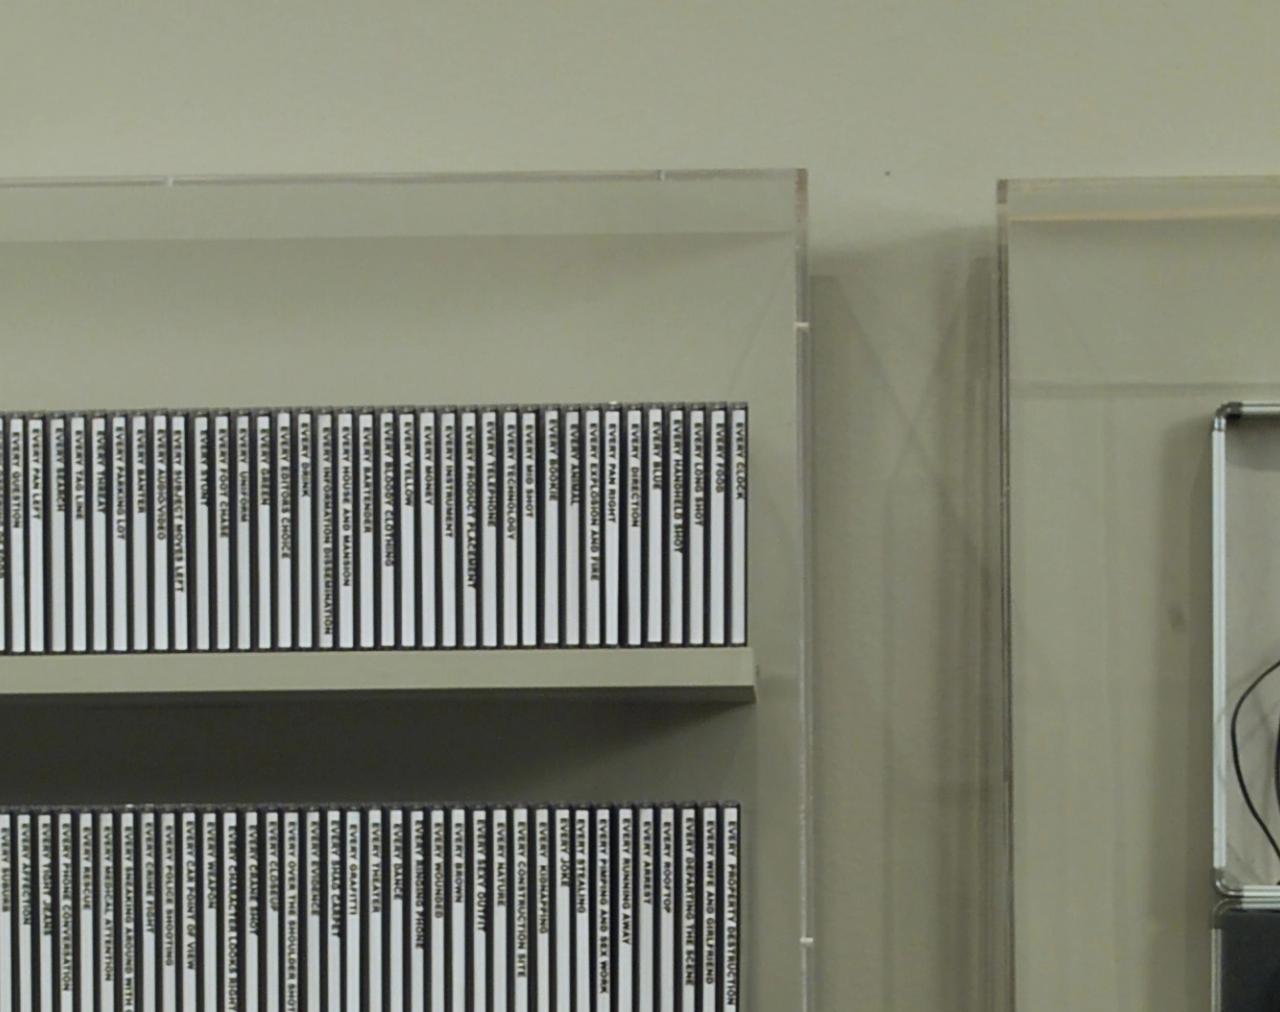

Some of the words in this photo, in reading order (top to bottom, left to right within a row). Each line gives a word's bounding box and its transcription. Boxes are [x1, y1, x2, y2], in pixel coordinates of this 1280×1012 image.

[11, 431, 22, 467] EVERY
[31, 428, 41, 463] EVERY
[239, 427, 248, 464] EVERY
[341, 425, 351, 462] EVERY
[362, 426, 373, 462] EVERY
[403, 421, 413, 457] EVERY
[424, 425, 432, 461] EVERY
[444, 424, 454, 461] EVERY
[486, 420, 497, 457] EVERY
[506, 423, 517, 460] EVERY
[524, 423, 535, 460] EVERY
[590, 422, 599, 458] EVERY
[607, 423, 616, 458] EVERY
[630, 423, 640, 462] EVERY
[652, 421, 662, 457] EVERY
[694, 422, 704, 458] EVERY
[715, 422, 725, 458] EVERY
[735, 421, 744, 457] EVERY
[32, 467, 41, 490] PAN
[341, 465, 351, 504] HOUSE
[404, 461, 413, 506] YELLOW
[424, 465, 433, 505] MONEY
[524, 463, 535, 485] MID
[607, 462, 616, 485] PAN
[652, 461, 662, 490] BLUE
[694, 461, 704, 492] LONG
[715, 462, 725, 493] FOOD
[735, 461, 744, 499] CLOCK
[11, 470, 23, 529] QUESTION
[32, 492, 42, 519] LEFT
[239, 470, 249, 523] UNIFORM
[362, 465, 373, 533] BARTENDER
[445, 464, 454, 538] INSTRUMENT
[486, 461, 497, 527] TELEPHONE
[506, 464, 517, 540] TECHNOLOGY
[524, 488, 535, 517] SHOT
[590, 462, 599, 526] EXPLOSION
[607, 488, 616, 522] RIGHT
[630, 466, 640, 527] DIRECTION
[694, 496, 703, 526] SHOT
[342, 508, 351, 531] AND
[590, 529, 599, 552] AND
[342, 534, 352, 586] MANSION
[590, 555, 599, 581] FIRE
[82, 825, 92, 862] EVERY
[287, 822, 296, 857] EVERY
[348, 823, 358, 859] EVERY
[371, 822, 380, 858] EVERY
[434, 821, 444, 858] EVERY
[454, 822, 463, 858] EVERY
[496, 821, 506, 858] EVERY
[517, 821, 526, 857] EVERY
[538, 821, 548, 860] EVERY
[560, 820, 570, 853] EVERY
[575, 819, 586, 855] EVERY
[622, 818, 631, 854] EVERY
[643, 820, 652, 856] EVERY
[663, 821, 672, 857] EVERY
[685, 818, 694, 853] EVERY
[706, 820, 714, 856] EVERY
[727, 820, 736, 858] EVERY
[82, 865, 92, 910] RESCUE
[287, 860, 296, 891] OVER
[371, 862, 381, 913] THEATER
[434, 861, 444, 918] WOUNDED
[454, 862, 463, 903] BROWN
[496, 861, 506, 906] NATURE
[560, 858, 570, 887] JOKE
[576, 858, 586, 914] STEALING
[622, 857, 631, 909] RUNNING
[643, 860, 652, 904] ARREST
[663, 861, 672, 913] ROOFTOP
[685, 856, 694, 920] DEPARTING
[706, 860, 714, 887] WIFE
[287, 894, 296, 916] THE
[517, 860, 527, 950] CONSTRUCTION
[538, 864, 548, 934] KIDNAPPING
[706, 890, 714, 914] AND
[727, 863, 736, 922] PROPERTY
[622, 913, 631, 944] AWAY
[685, 924, 694, 946] THE
[287, 919, 296, 980] SHOULDER
[517, 953, 527, 978] SITE
[685, 949, 694, 986] SCENE
[705, 917, 714, 984] GIRLFRIEND
[727, 925, 736, 1005] DESTRUCTION
[287, 983, 296, 1012] SHOT
